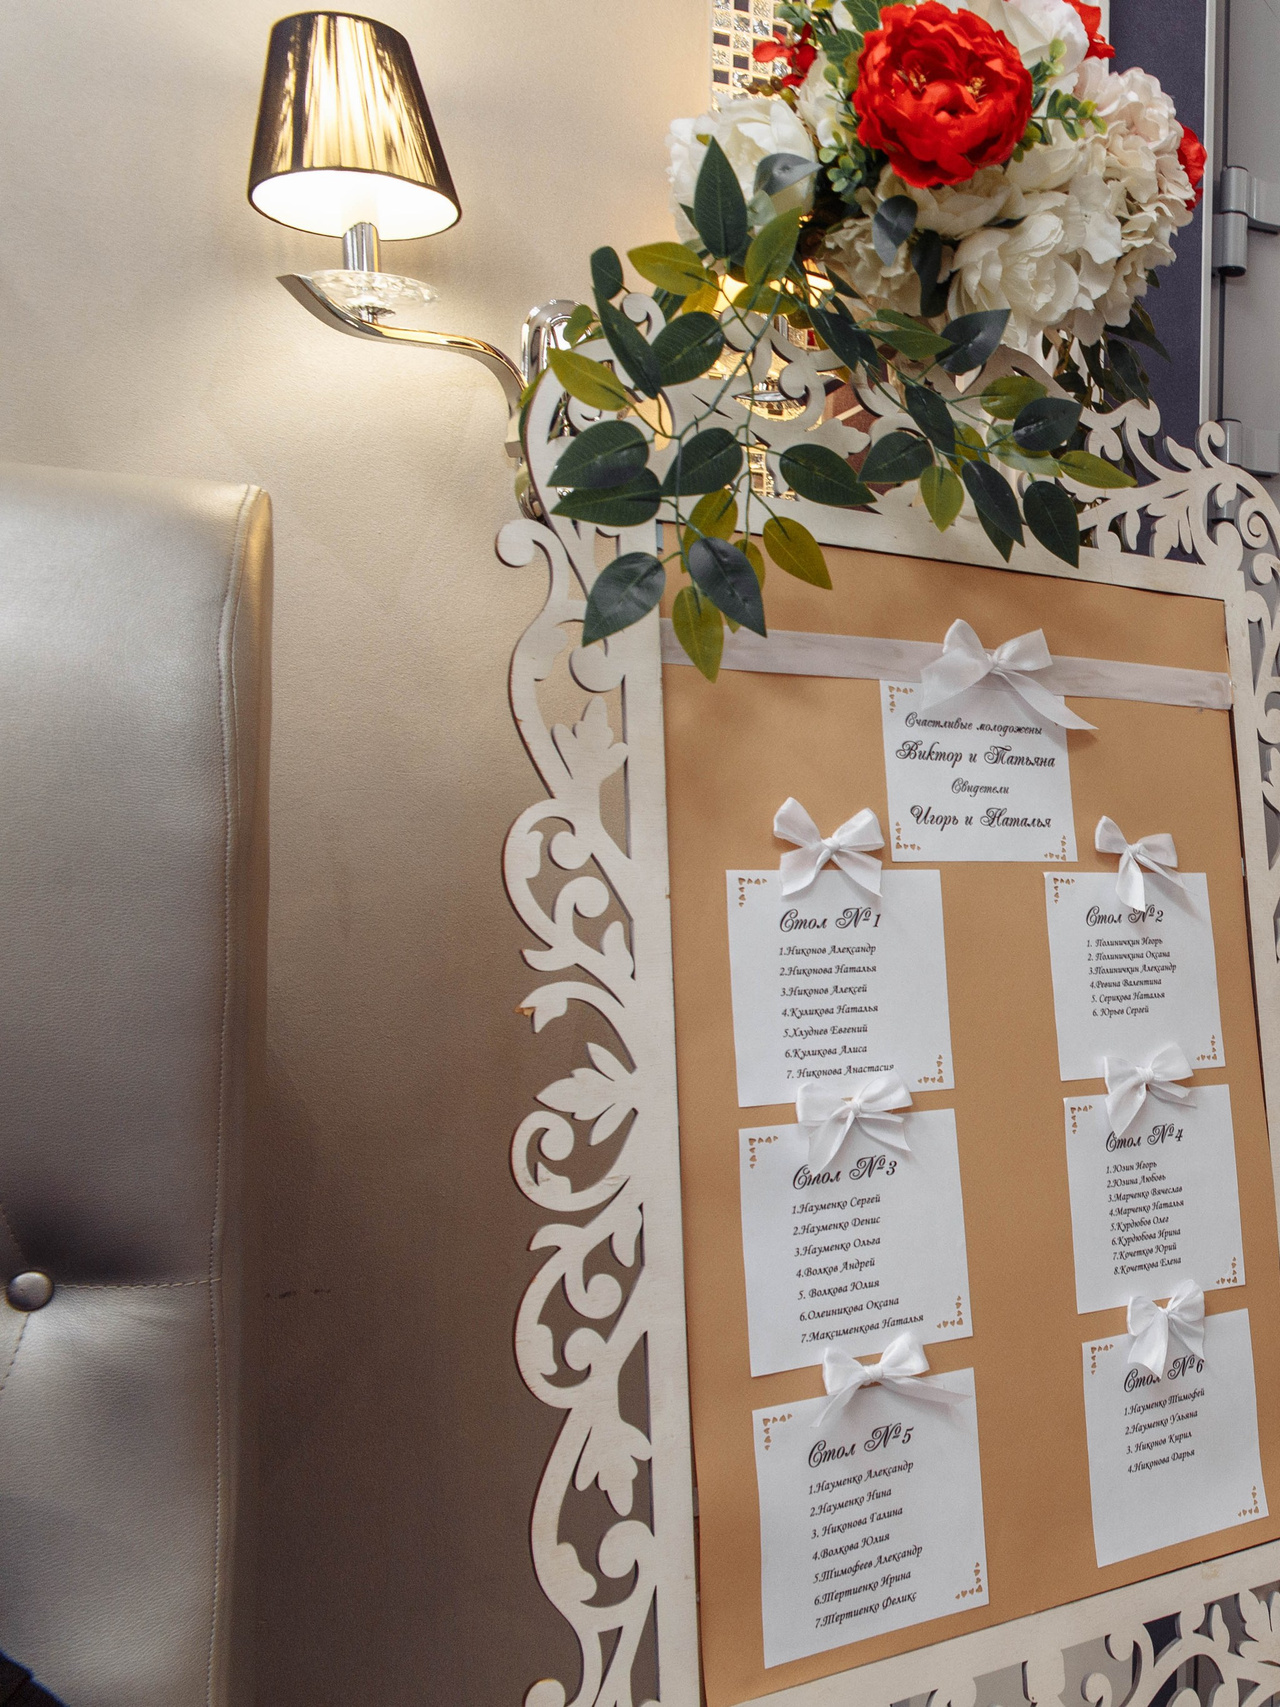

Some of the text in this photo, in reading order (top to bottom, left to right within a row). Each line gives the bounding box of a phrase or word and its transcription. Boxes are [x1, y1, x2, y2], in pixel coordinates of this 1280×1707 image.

[905, 711, 1043, 737] Счастливые молодожены
[895, 740, 1056, 769] Виктор и Татьяна
[951, 777, 1009, 798] Свидетели
[910, 805, 1052, 832] Игорь и Наталья
[779, 908, 828, 933] Стол
[1085, 905, 1122, 927] Стол
[1141, 936, 1163, 947] Игорь
[827, 943, 876, 956] Александр
[1145, 950, 1170, 960] Оксана
[834, 964, 877, 974] Наталья
[1140, 962, 1177, 973] Александр
[1122, 979, 1162, 987] Валентина
[830, 984, 867, 996] Алексей
[1133, 991, 1165, 1001] Наталья
[836, 1004, 879, 1015] Наталья
[1125, 1005, 1149, 1017] Сергей
[830, 1024, 868, 1035] Евгений
[839, 1045, 867, 1056] Алиса
[797, 1067, 842, 1079] Никонова
[1105, 1130, 1142, 1153] Стол
[1135, 1160, 1157, 1171] Игорь
[792, 1164, 841, 1190] Стол
[1139, 1172, 1166, 1185] Любовь
[1150, 1186, 1183, 1196] Вячеслав
[850, 1194, 881, 1208] Сергей
[1152, 1200, 1184, 1211] Наталья
[851, 1216, 881, 1227] Денис
[1152, 1216, 1169, 1225] Олег
[1157, 1228, 1181, 1240] Ирина
[853, 1237, 881, 1248] Ольга
[1154, 1242, 1177, 1254] Юрий
[839, 1257, 875, 1273] Андрей
[1159, 1257, 1181, 1267] Елена
[808, 1285, 848, 1298] Волкова
[850, 1280, 880, 1292] Юлия
[866, 1298, 899, 1310] Оксана
[881, 1314, 924, 1329] Наталья
[1168, 1388, 1205, 1405] Тимофей
[1169, 1410, 1198, 1425] Ульяна
[1134, 1438, 1167, 1453] Никонов
[808, 1439, 856, 1468] Стол
[1171, 1449, 1195, 1462] Дарья
[864, 1461, 914, 1482] Александр
[866, 1488, 892, 1502] Нина
[821, 1517, 867, 1537] Никонова
[869, 1507, 903, 1523] Галина
[861, 1533, 890, 1548] Юлия
[873, 1544, 923, 1568] Александр
[880, 1571, 911, 1588] Ирина
[882, 1592, 917, 1610] Феликс
